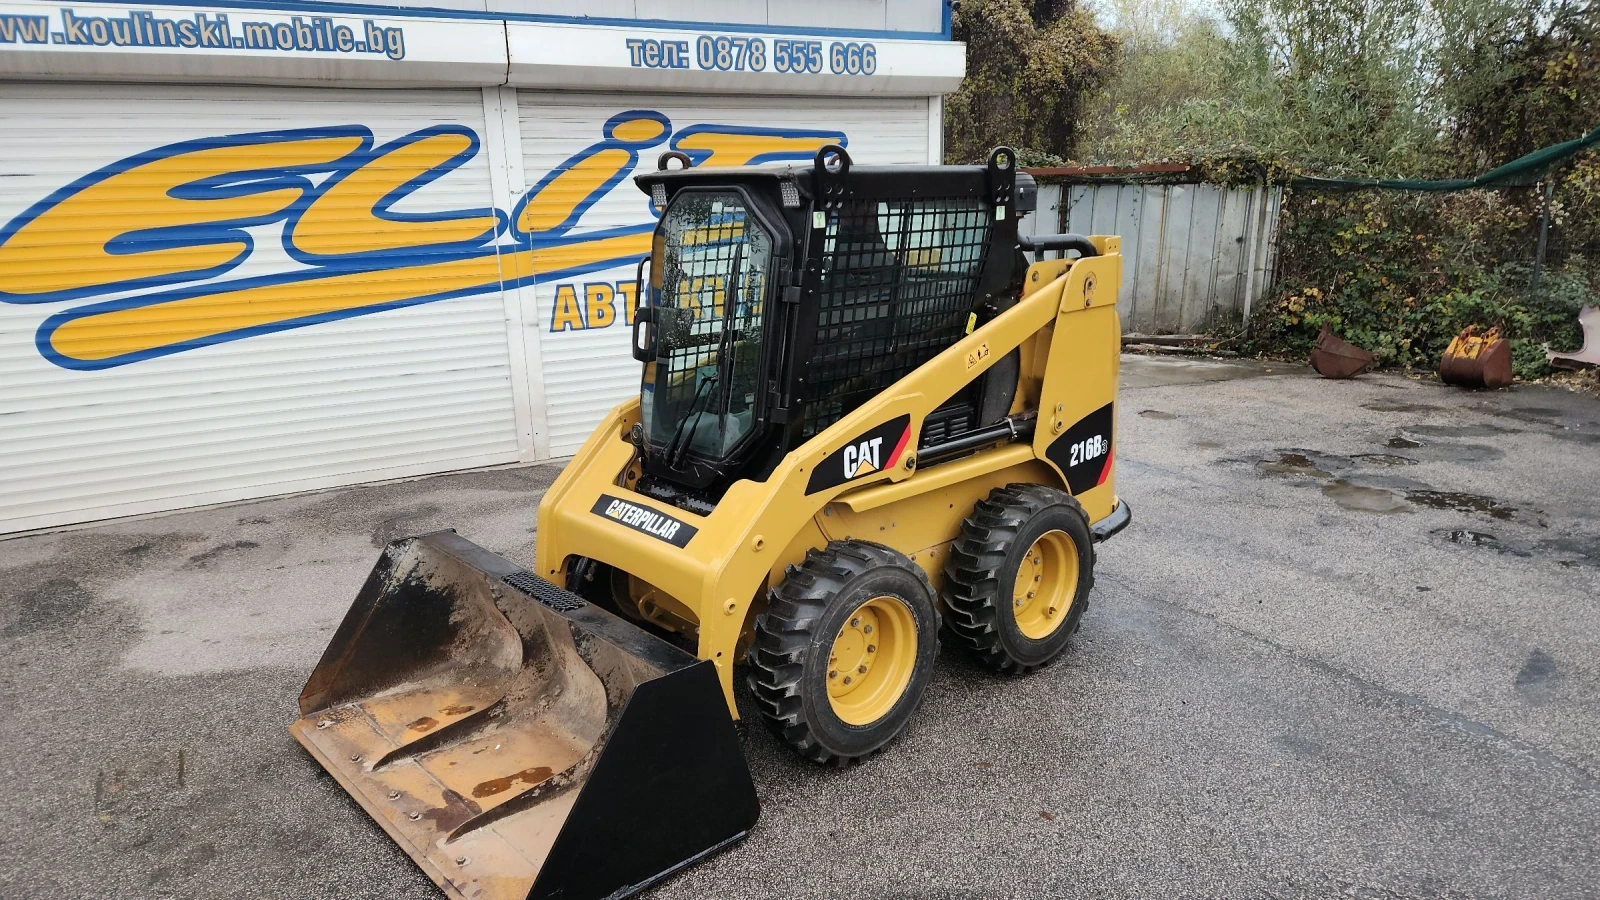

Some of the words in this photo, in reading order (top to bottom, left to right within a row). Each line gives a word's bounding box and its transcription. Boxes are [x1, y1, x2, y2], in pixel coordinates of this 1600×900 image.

[626, 38, 690, 69] тел:
[697, 35, 767, 72] 0878
[774, 39, 823, 74] 555
[830, 41, 876, 75] 666
[843, 437, 882, 479] CAT
[605, 499, 680, 540] CATERPILLAR
